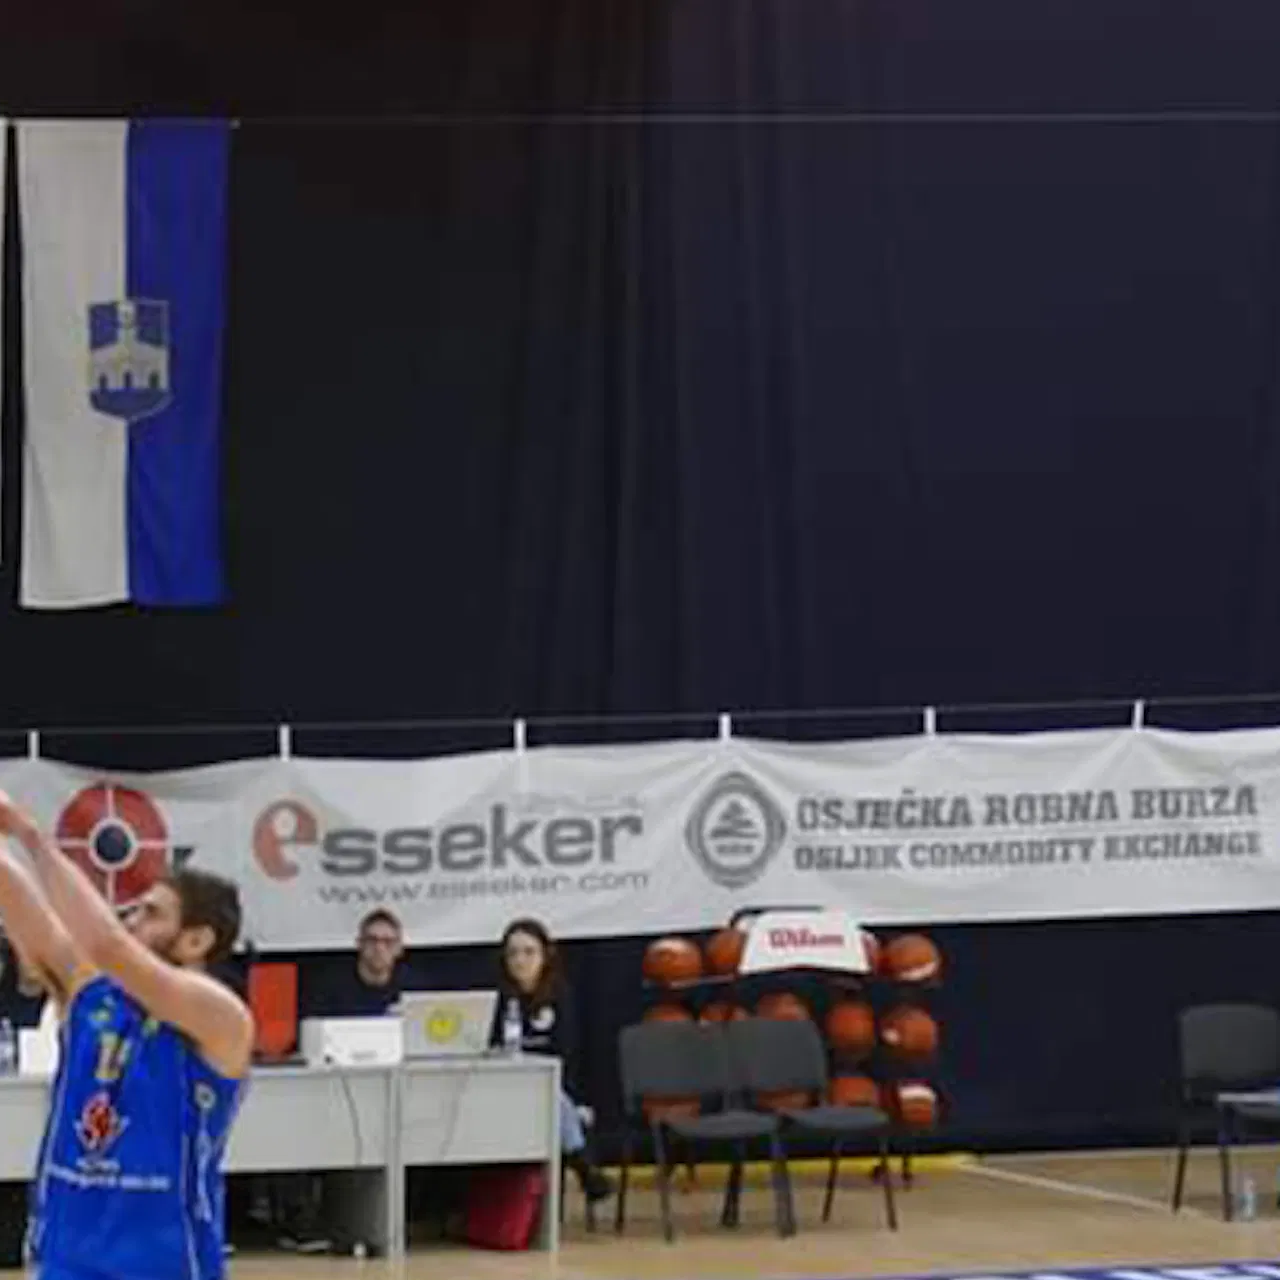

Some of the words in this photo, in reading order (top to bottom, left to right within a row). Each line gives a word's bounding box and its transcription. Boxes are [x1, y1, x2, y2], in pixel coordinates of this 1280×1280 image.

[797, 786, 973, 831] OSJEČKA
[983, 789, 1119, 828] ROBNA
[1131, 784, 1258, 820] BURZA
[252, 798, 644, 882] esseker
[909, 837, 1095, 868] COMMODITY
[1104, 830, 1262, 861] EXCHANGE
